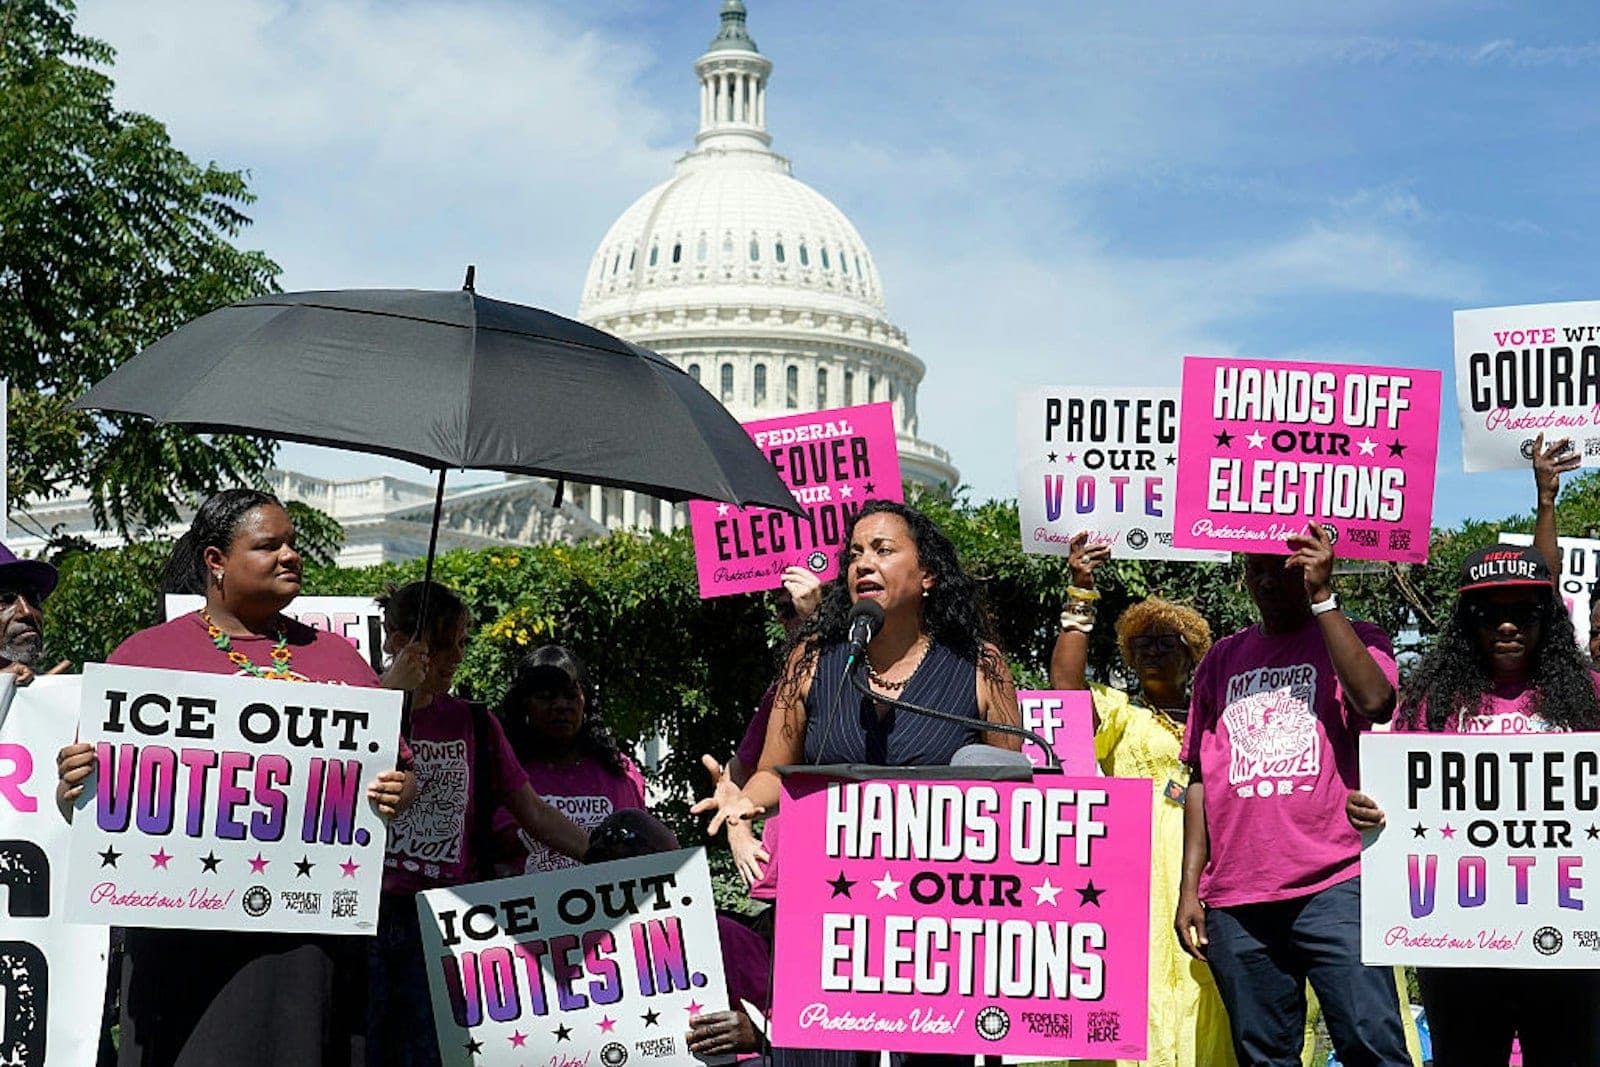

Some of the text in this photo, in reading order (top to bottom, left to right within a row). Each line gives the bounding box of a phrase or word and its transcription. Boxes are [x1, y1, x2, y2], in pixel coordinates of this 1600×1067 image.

[1494, 326, 1600, 347] VOTE WIT
[1470, 346, 1600, 413] COURA
[1213, 366, 1412, 429] HANDS OFF
[754, 420, 853, 448] FEDERAL
[1045, 398, 1175, 445] PROTEC
[1486, 407, 1554, 432] Protect
[1553, 412, 1588, 427] our
[1083, 448, 1156, 471] OUR
[1271, 429, 1351, 456] OUR
[1043, 474, 1163, 522] VOTE
[1207, 457, 1406, 522] ELECTIONS
[714, 501, 858, 561] ELECTION
[1191, 519, 1249, 541] Protect
[1247, 528, 1268, 541] our
[1470, 560, 1537, 580] CULTURE
[1230, 666, 1313, 698] MY POWER
[102, 690, 380, 754] ICE OUT.
[1018, 698, 1065, 745] FF
[411, 742, 465, 762] POWER
[1231, 748, 1257, 784] MY
[96, 741, 292, 844] VOTES
[301, 756, 372, 847] IN.
[1407, 751, 1600, 812] PROTEC
[556, 798, 609, 815] POWER
[825, 782, 1108, 867] HANDS OFF
[1467, 819, 1573, 849] OUR
[90, 881, 160, 910] Protect
[157, 893, 185, 910] our
[187, 887, 235, 912] Vote!
[908, 871, 1023, 908] OUR
[1407, 854, 1584, 919] VOTE
[439, 873, 693, 947] ICE OUT.
[1384, 926, 1448, 949] Protect
[1447, 936, 1476, 950] our
[1477, 929, 1524, 951] Vote!
[440, 916, 708, 1028] VOTES IN.
[821, 912, 1107, 1001] ELECTIONS
[799, 1002, 878, 1031] Protect
[874, 1016, 908, 1033] our
[908, 1008, 964, 1036] Vote!
[1021, 1012, 1069, 1024] PEOPLE'S
[1029, 1023, 1069, 1034] ACTION
[1088, 1026, 1121, 1043] HERE
